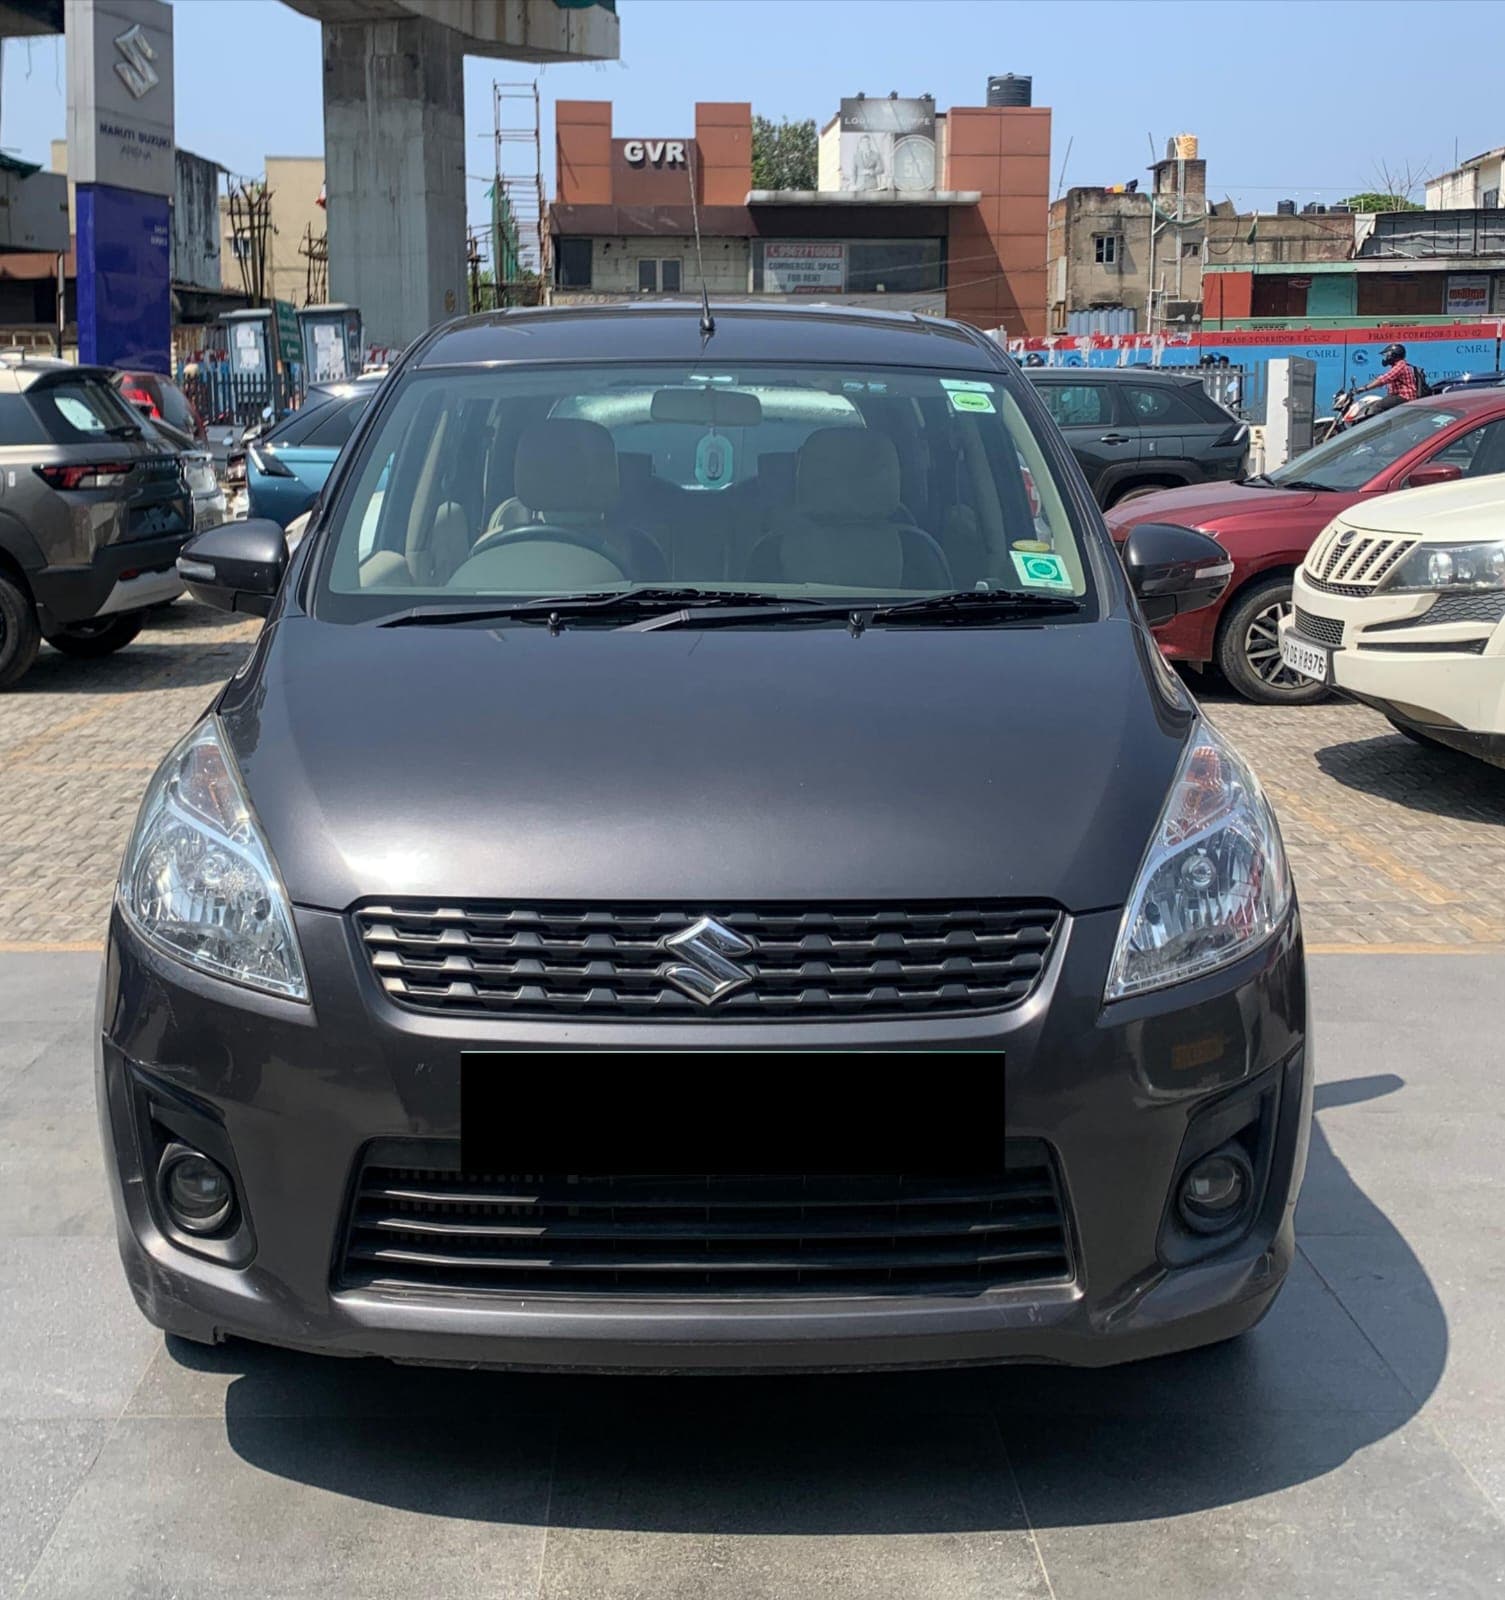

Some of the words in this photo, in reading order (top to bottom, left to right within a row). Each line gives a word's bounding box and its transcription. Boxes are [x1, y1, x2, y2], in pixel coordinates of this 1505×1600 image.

[100, 122, 136, 140] MARUTI
[624, 141, 685, 162] GVR
[768, 262, 816, 271] COMMERCIAL
[817, 262, 841, 271] SPACE
[787, 273, 801, 282] FOR
[803, 273, 822, 282] RENT
[1306, 349, 1340, 359] CMRL
[1456, 344, 1491, 354] CMRL
